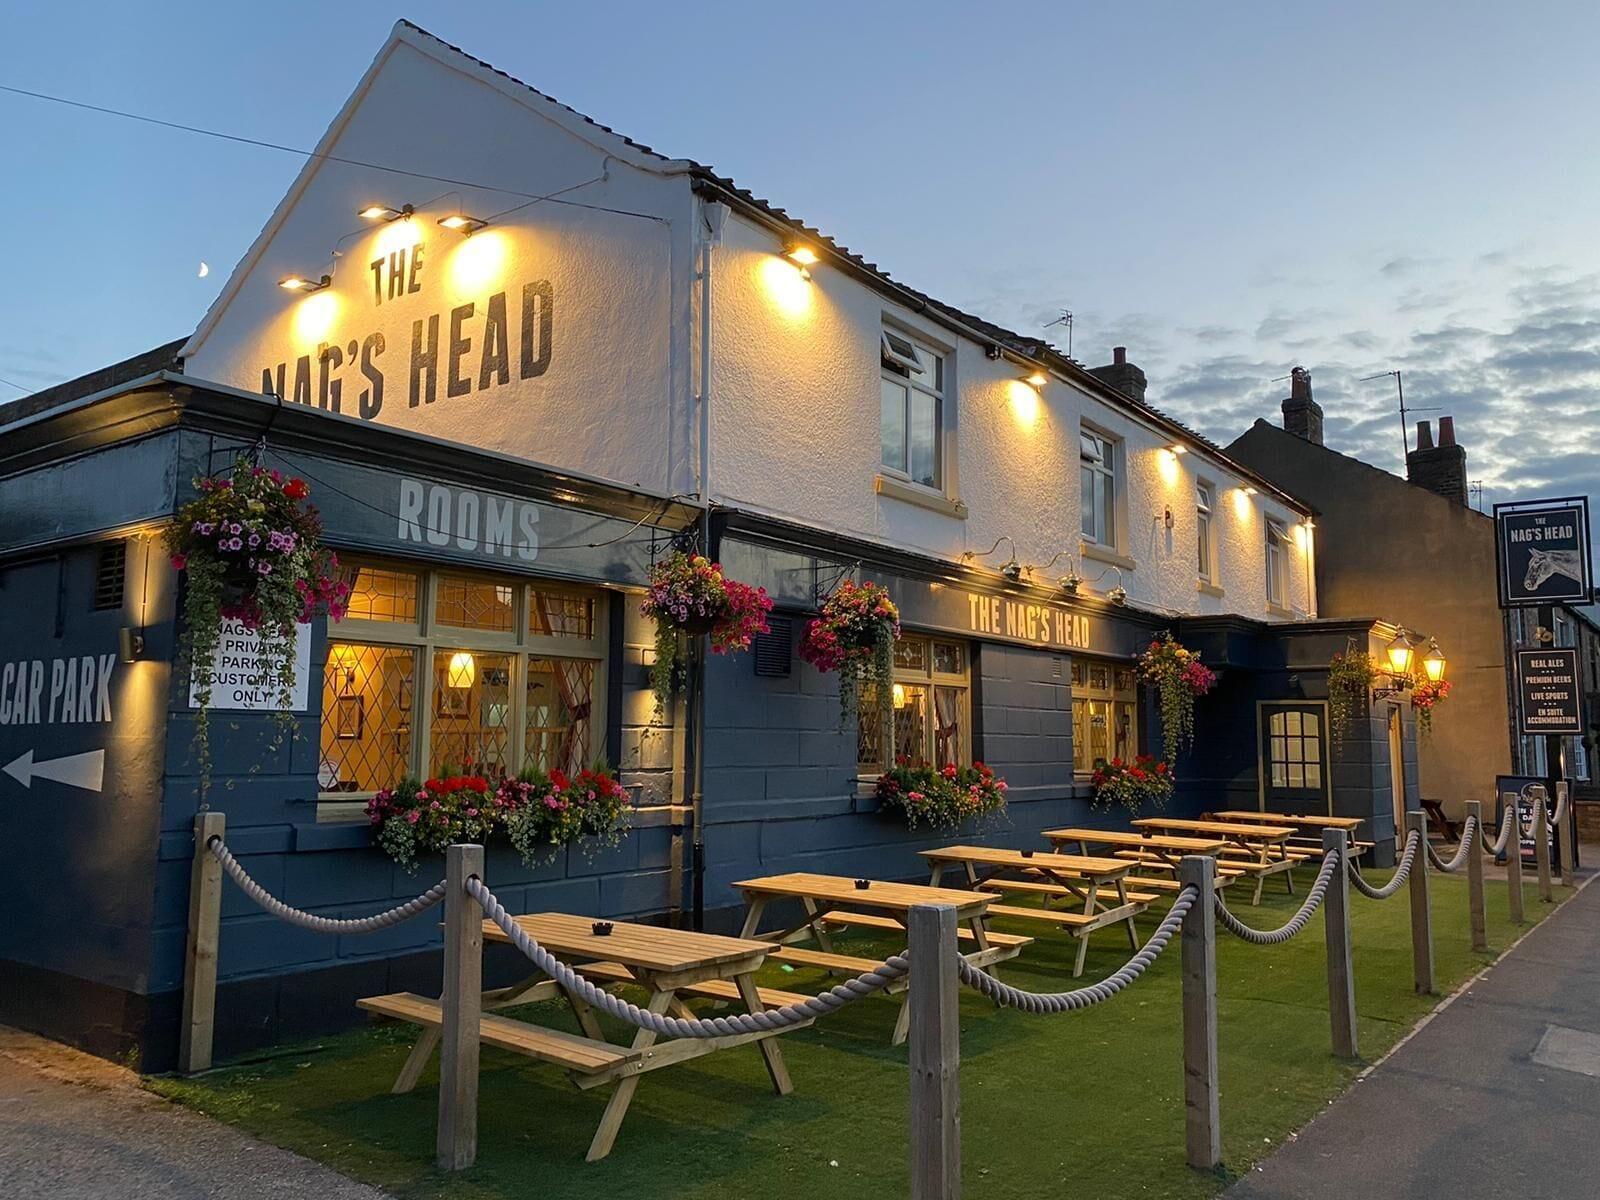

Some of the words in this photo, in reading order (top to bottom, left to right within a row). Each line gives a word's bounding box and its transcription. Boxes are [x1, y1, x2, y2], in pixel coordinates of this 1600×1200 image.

[370, 243, 425, 306] THE
[408, 279, 554, 409] HEAD
[398, 478, 540, 561] ROOMS
[1534, 517, 1547, 525] THE
[1510, 527, 1542, 542] NAG'S
[1544, 525, 1573, 540] HEAD
[968, 593, 1000, 634] THE
[1006, 601, 1050, 642] NAG'S
[1055, 611, 1090, 649] HEAD
[225, 640, 283, 655] PRIVAT
[222, 656, 285, 671] PARKNG
[1530, 659, 1547, 668] REAL
[1548, 659, 1564, 668] ALES
[1553, 675, 1572, 683] BEERS
[0, 660, 44, 725] CAR
[48, 653, 116, 723] PARK
[233, 689, 271, 702] ONLY
[1531, 692, 1545, 700] LIVE
[1545, 691, 1569, 700] SPORTS
[1546, 708, 1563, 716] SUITE
